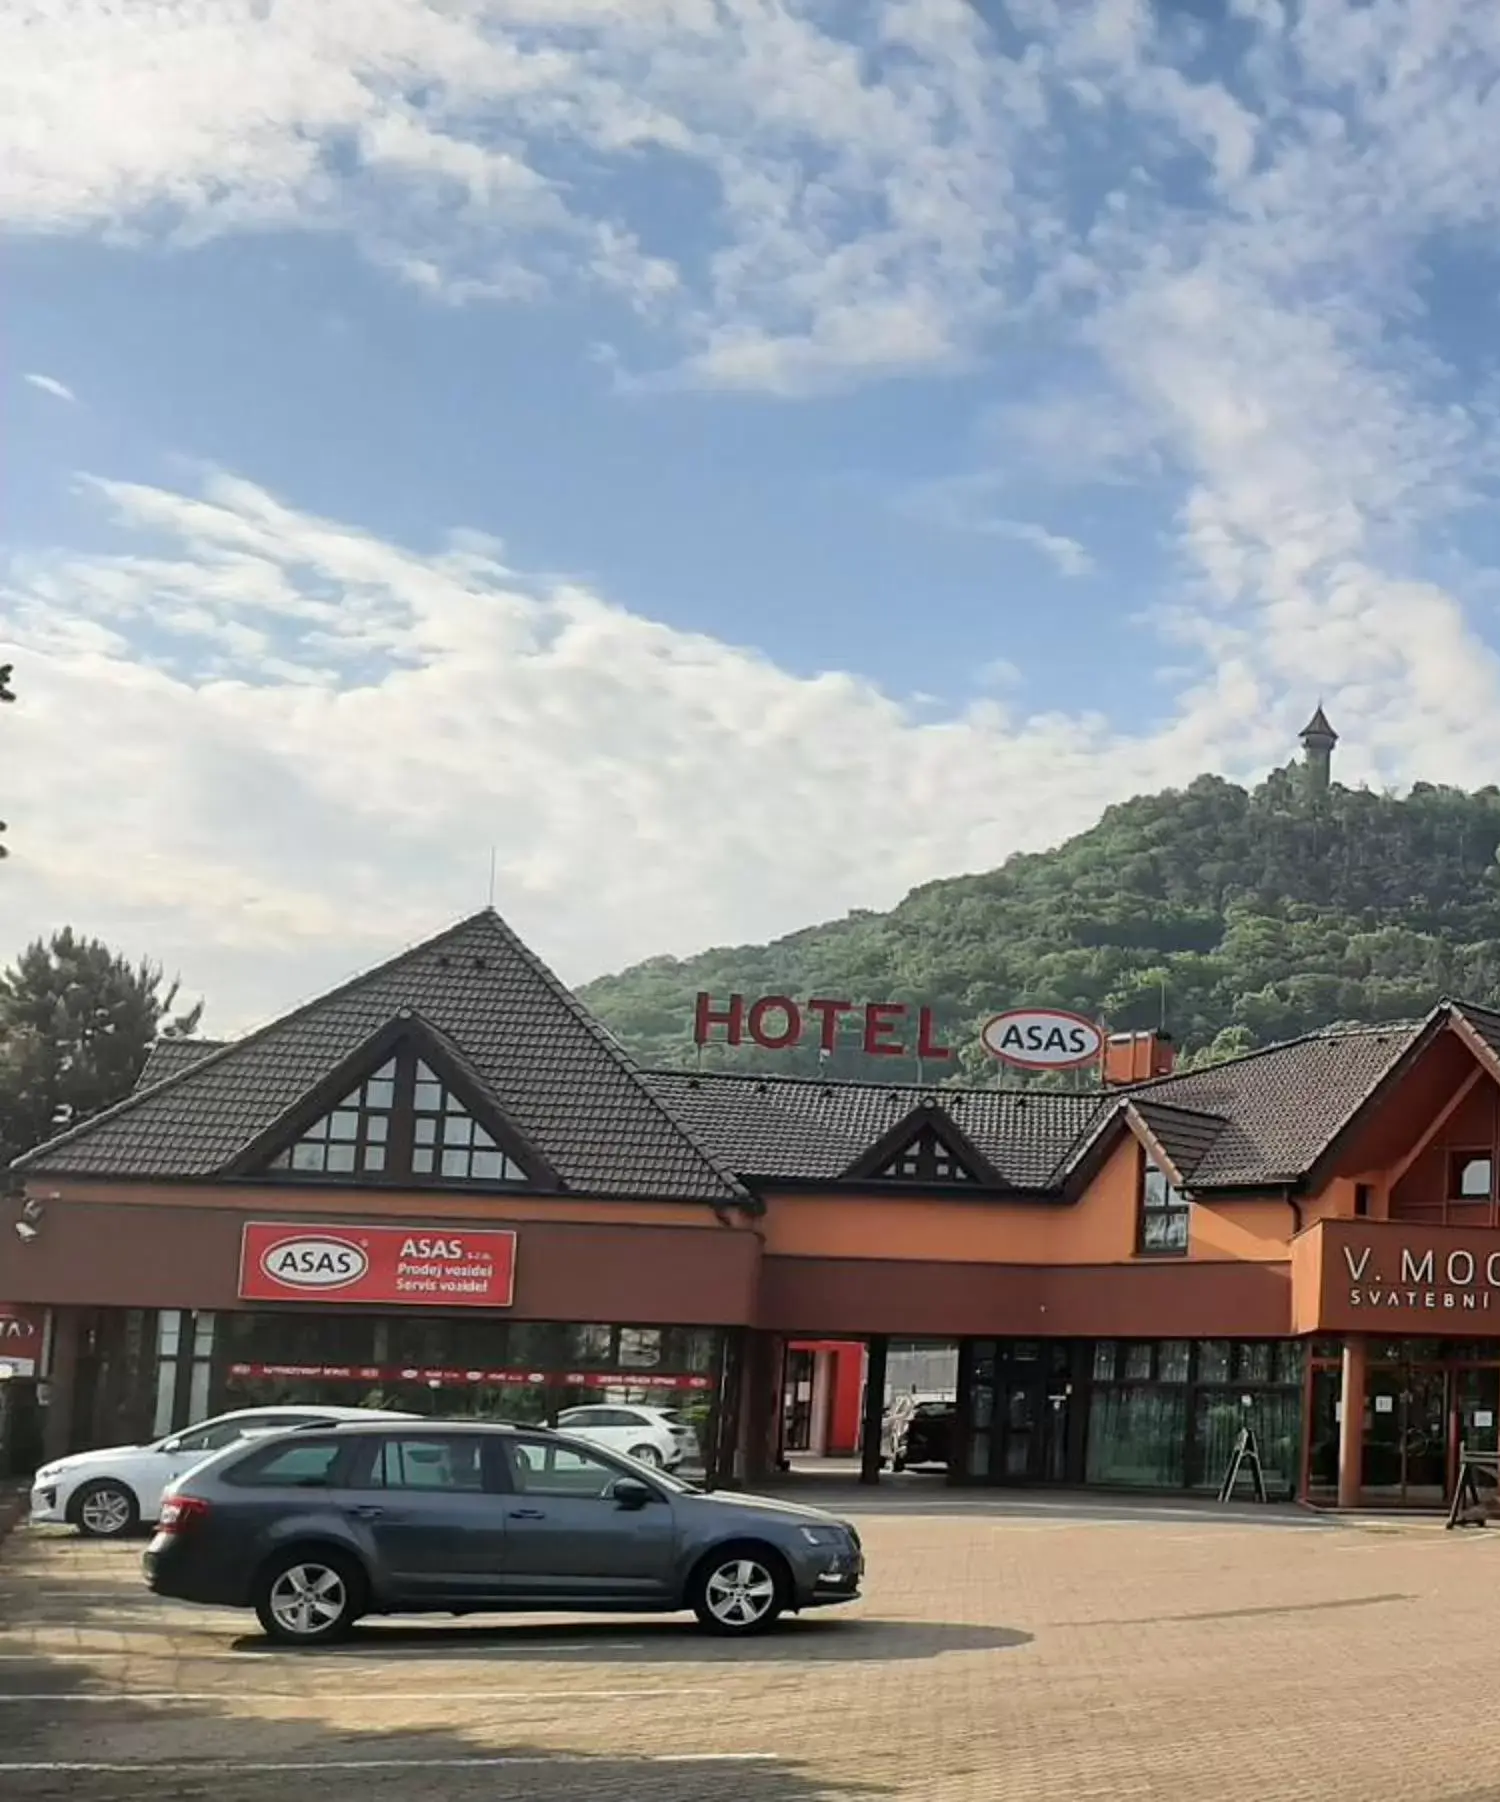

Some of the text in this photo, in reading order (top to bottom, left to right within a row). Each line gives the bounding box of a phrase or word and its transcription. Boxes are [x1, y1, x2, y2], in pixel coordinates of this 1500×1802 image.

[693, 991, 953, 1059] HOTEL
[1000, 1023, 1087, 1053] ASAS
[400, 1237, 463, 1260] ASAS
[278, 1250, 352, 1274] ASAS
[397, 1263, 493, 1278] Prodej vozidel
[1343, 1246, 1382, 1282] V.
[396, 1277, 489, 1293] Servis vozidel
[1351, 1289, 1489, 1309] SVATEBNÍ
